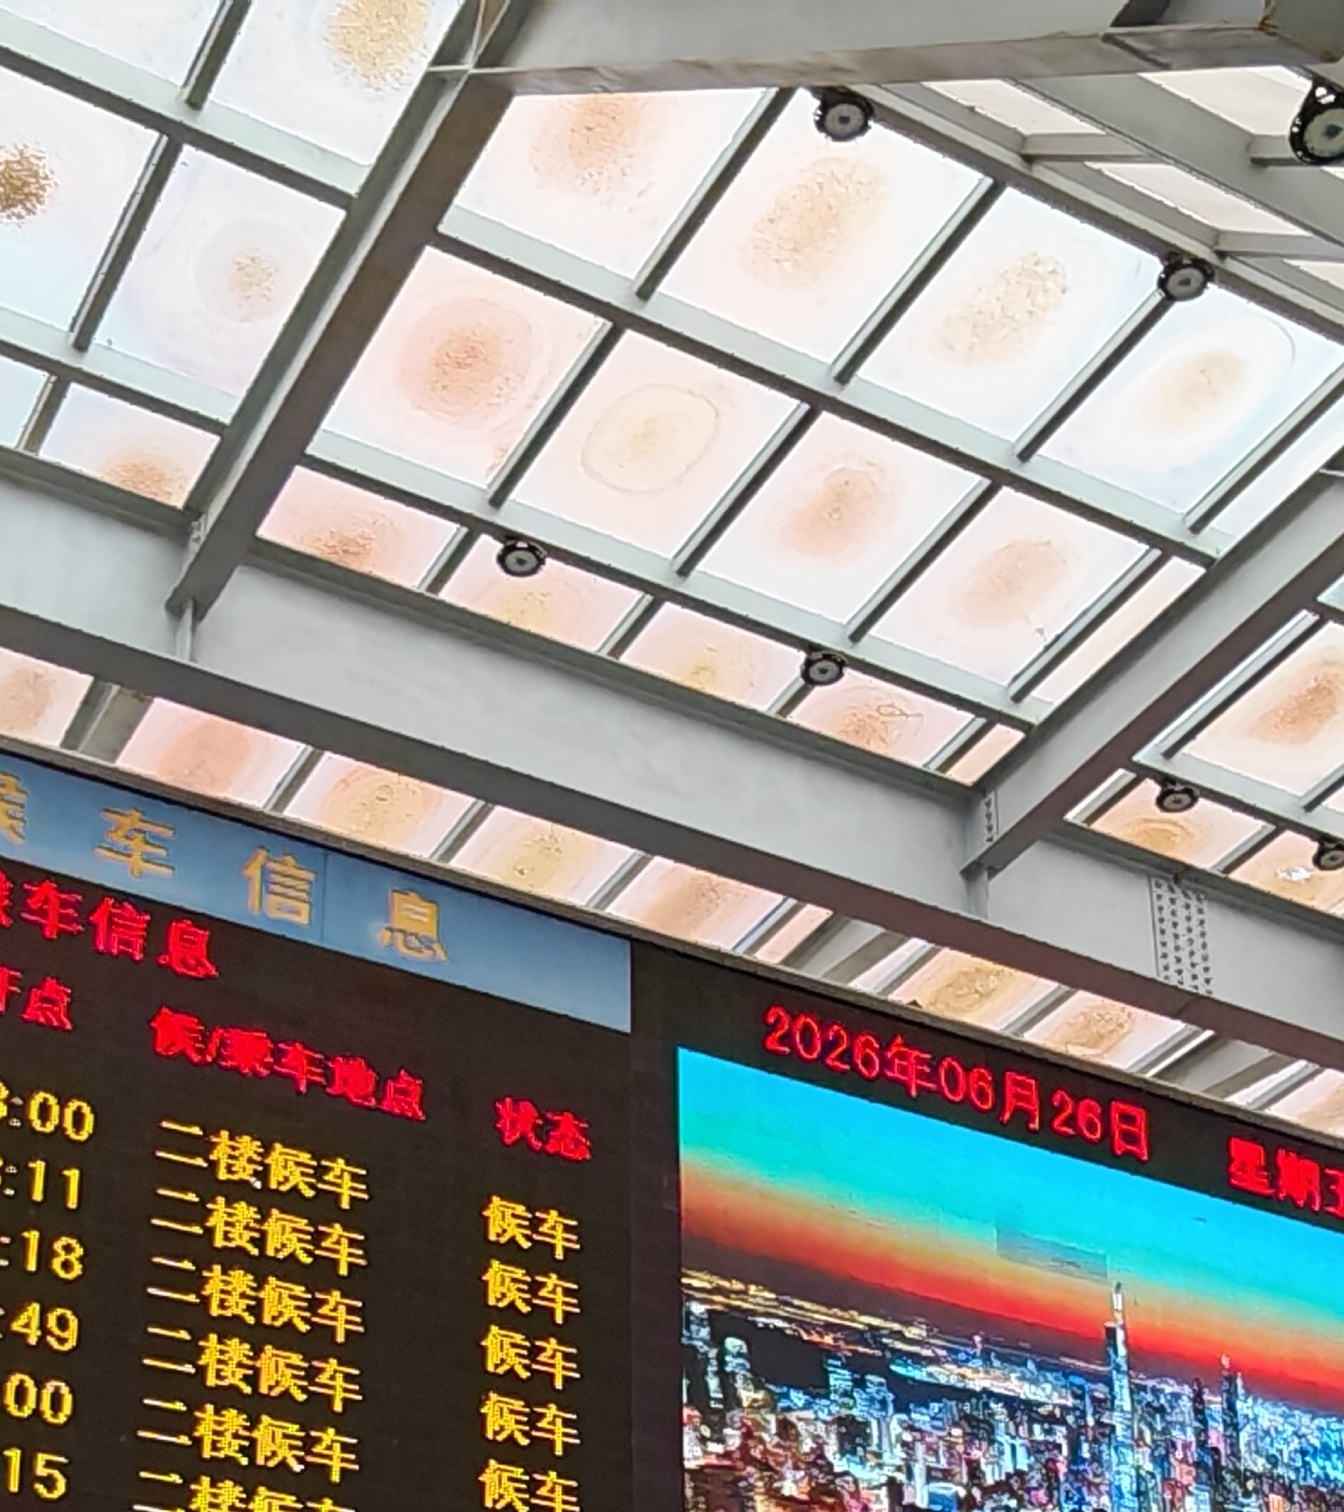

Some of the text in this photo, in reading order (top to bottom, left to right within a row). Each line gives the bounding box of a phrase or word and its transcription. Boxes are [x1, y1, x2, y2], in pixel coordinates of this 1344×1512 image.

[494, 1097, 591, 1160] 状态
[762, 1006, 1151, 1163] 2026年06月26日
[152, 1189, 367, 1275] 二楼候车
[479, 1260, 581, 1324] 候车
[156, 1120, 369, 1209] 二楼候车
[479, 1196, 581, 1260] 候车
[148, 1256, 363, 1343] 二楼候车
[479, 1325, 581, 1390] 候车
[138, 1399, 358, 1483] 二楼候车
[143, 1327, 362, 1413] 二楼候车
[479, 1392, 581, 1456] 候车
